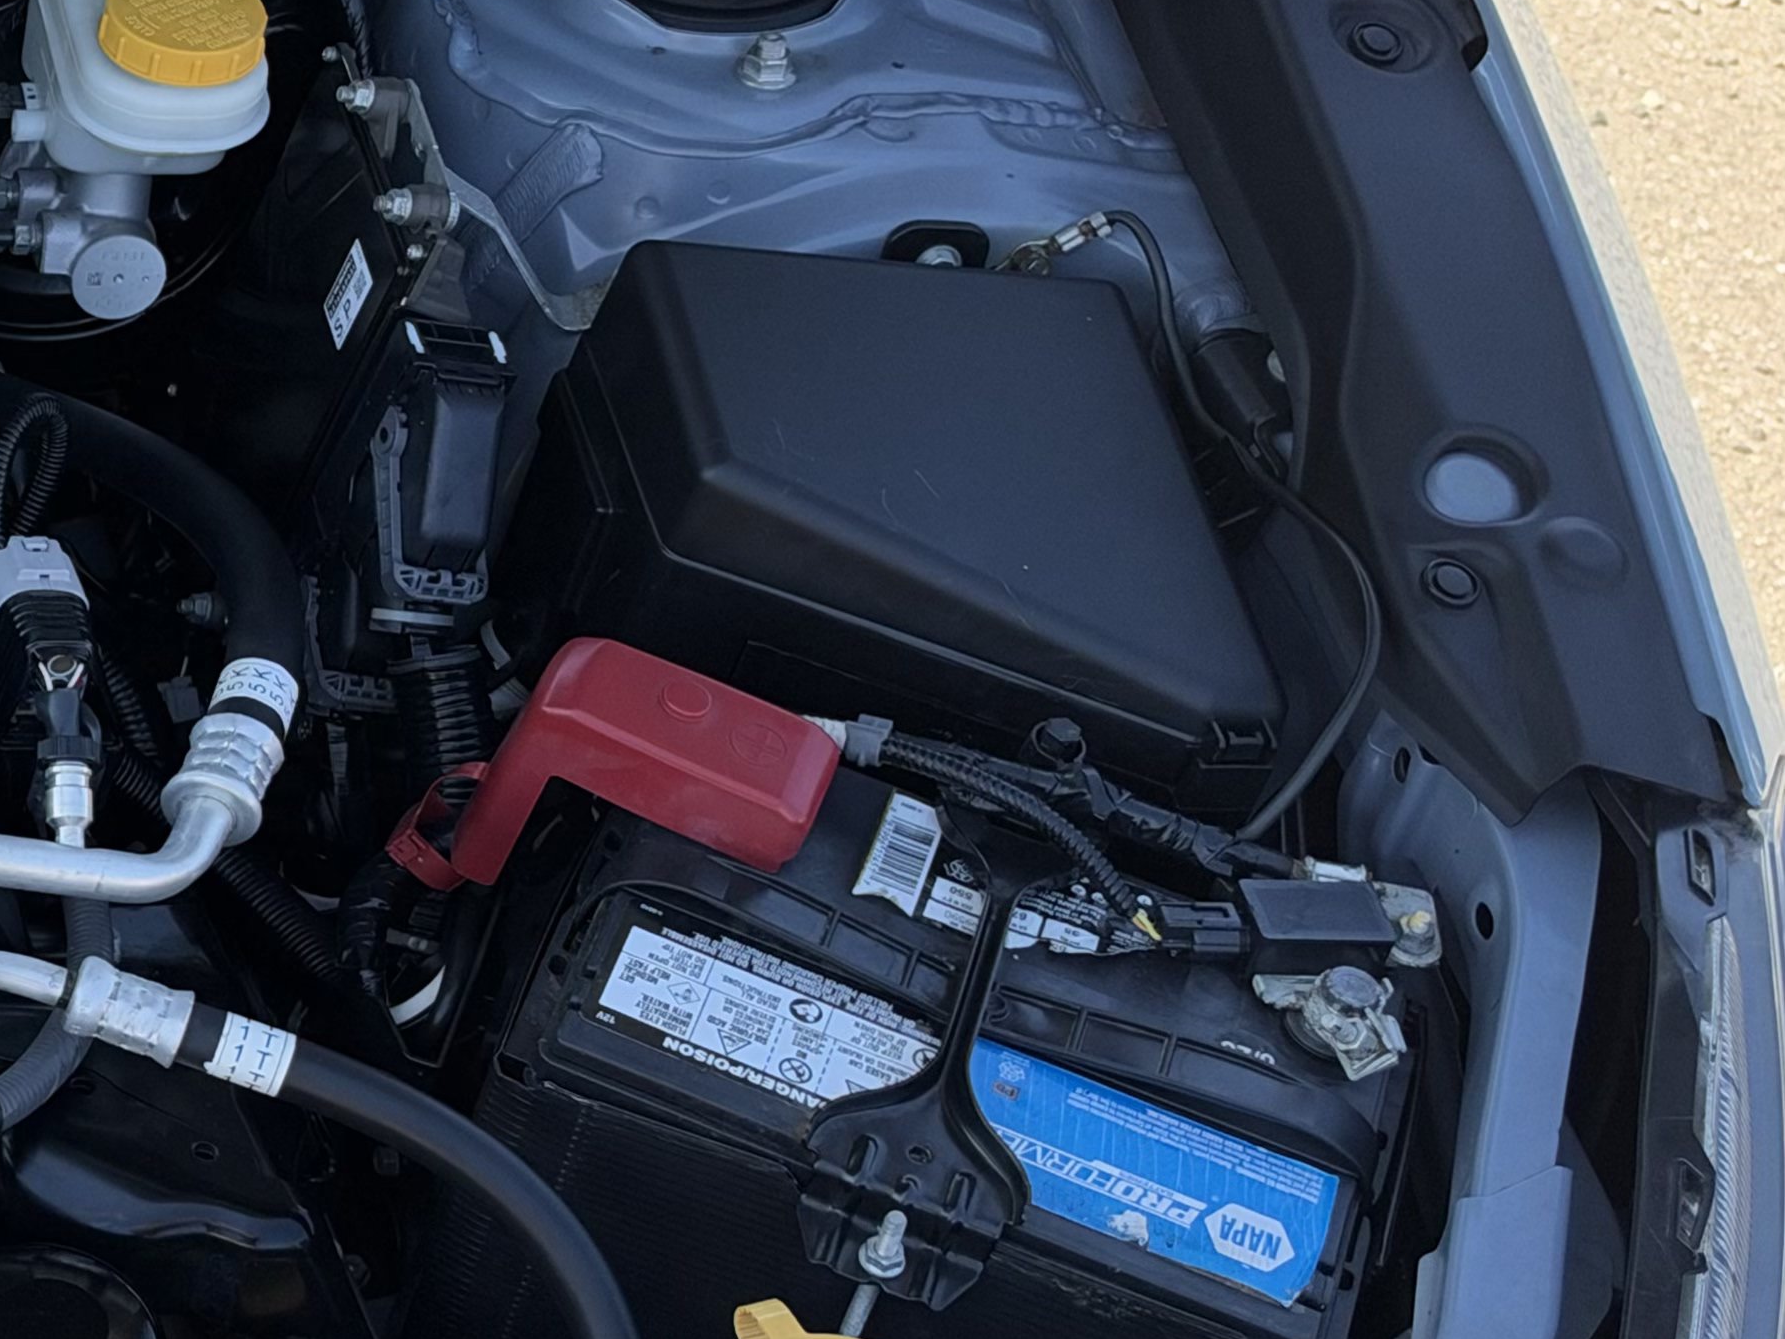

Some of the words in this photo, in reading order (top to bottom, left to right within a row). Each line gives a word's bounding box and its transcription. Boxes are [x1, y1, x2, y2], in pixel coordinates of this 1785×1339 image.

[595, 1009, 616, 1024] 12V
[638, 1009, 660, 1024] EYES
[996, 1127, 1203, 1222] PROFORME
[1212, 1212, 1285, 1261] NAPA
